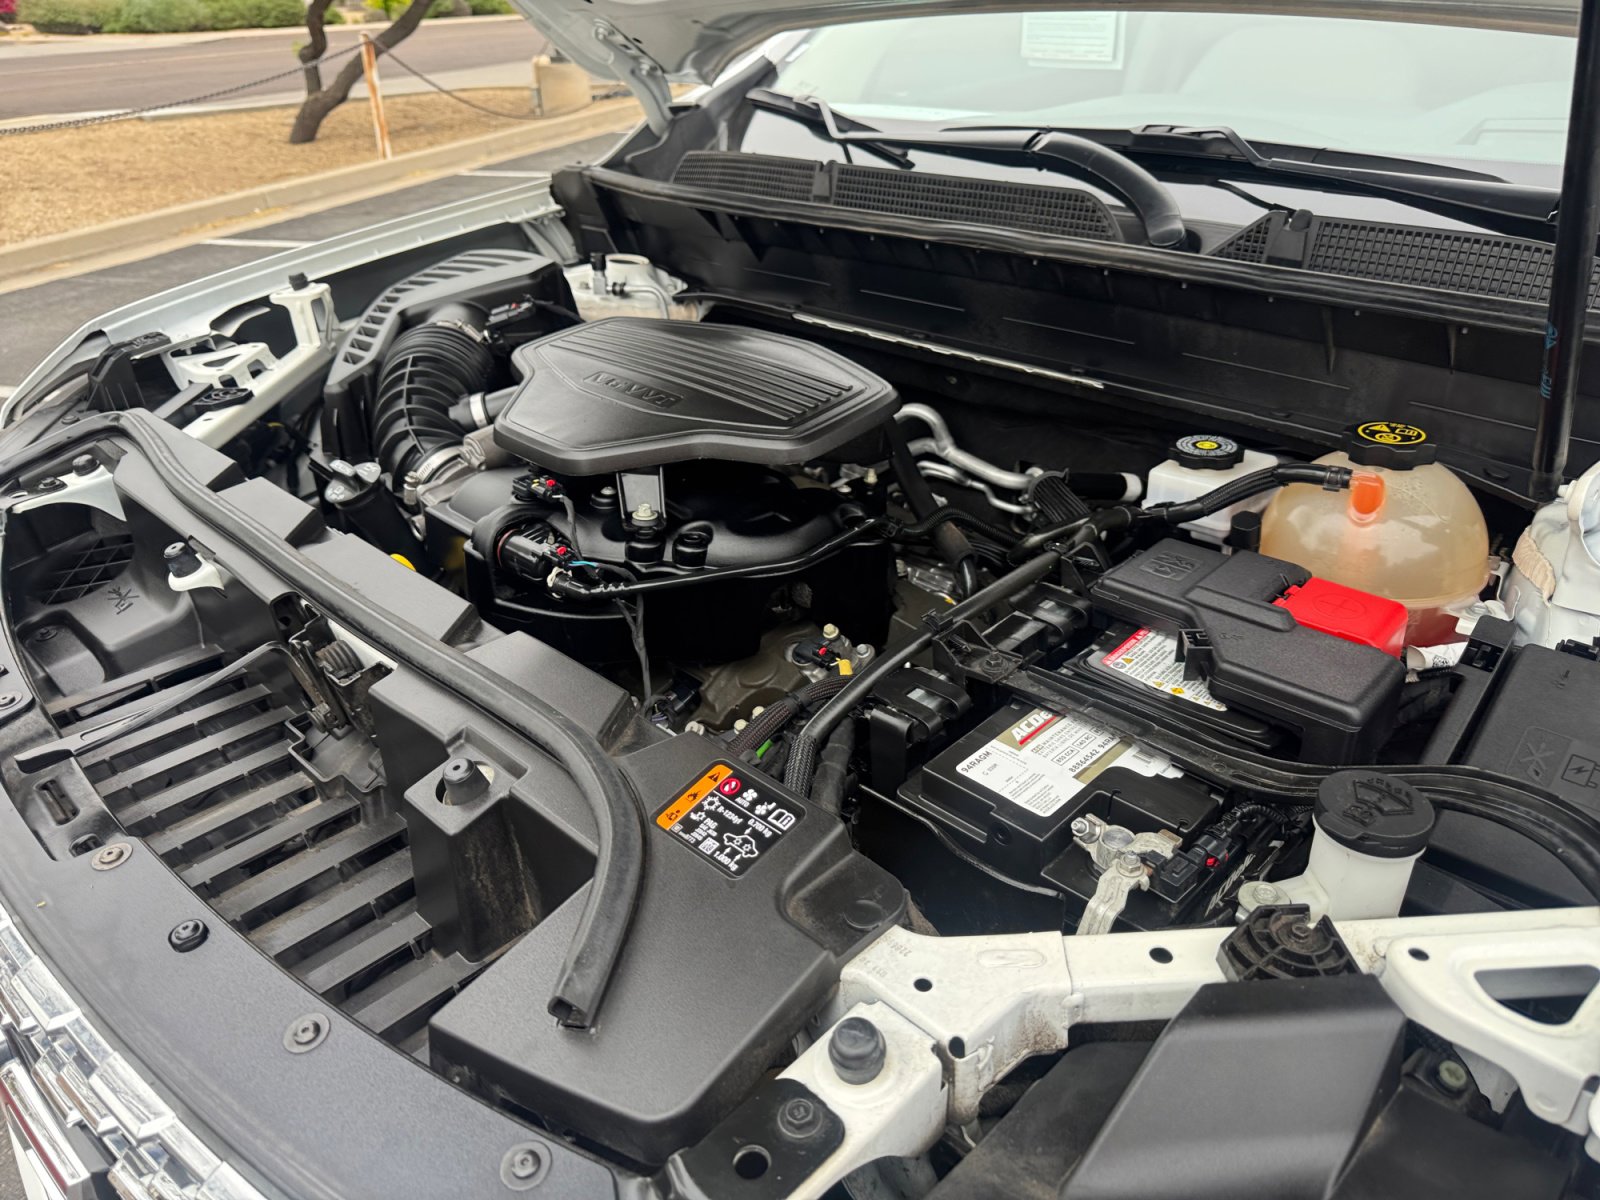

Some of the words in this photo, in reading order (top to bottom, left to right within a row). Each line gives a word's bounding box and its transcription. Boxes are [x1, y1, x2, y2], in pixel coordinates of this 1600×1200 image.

[961, 750, 992, 773] 94RAGM
[1068, 748, 1099, 773] 88864542
[735, 797, 750, 808] AUTO
[703, 818, 718, 829] PAG
[717, 806, 743, 825] R-1234yf
[747, 818, 766, 832] 0.700
[762, 828, 773, 838] kg
[714, 851, 732, 865] 1.000
[728, 861, 739, 871] kg
